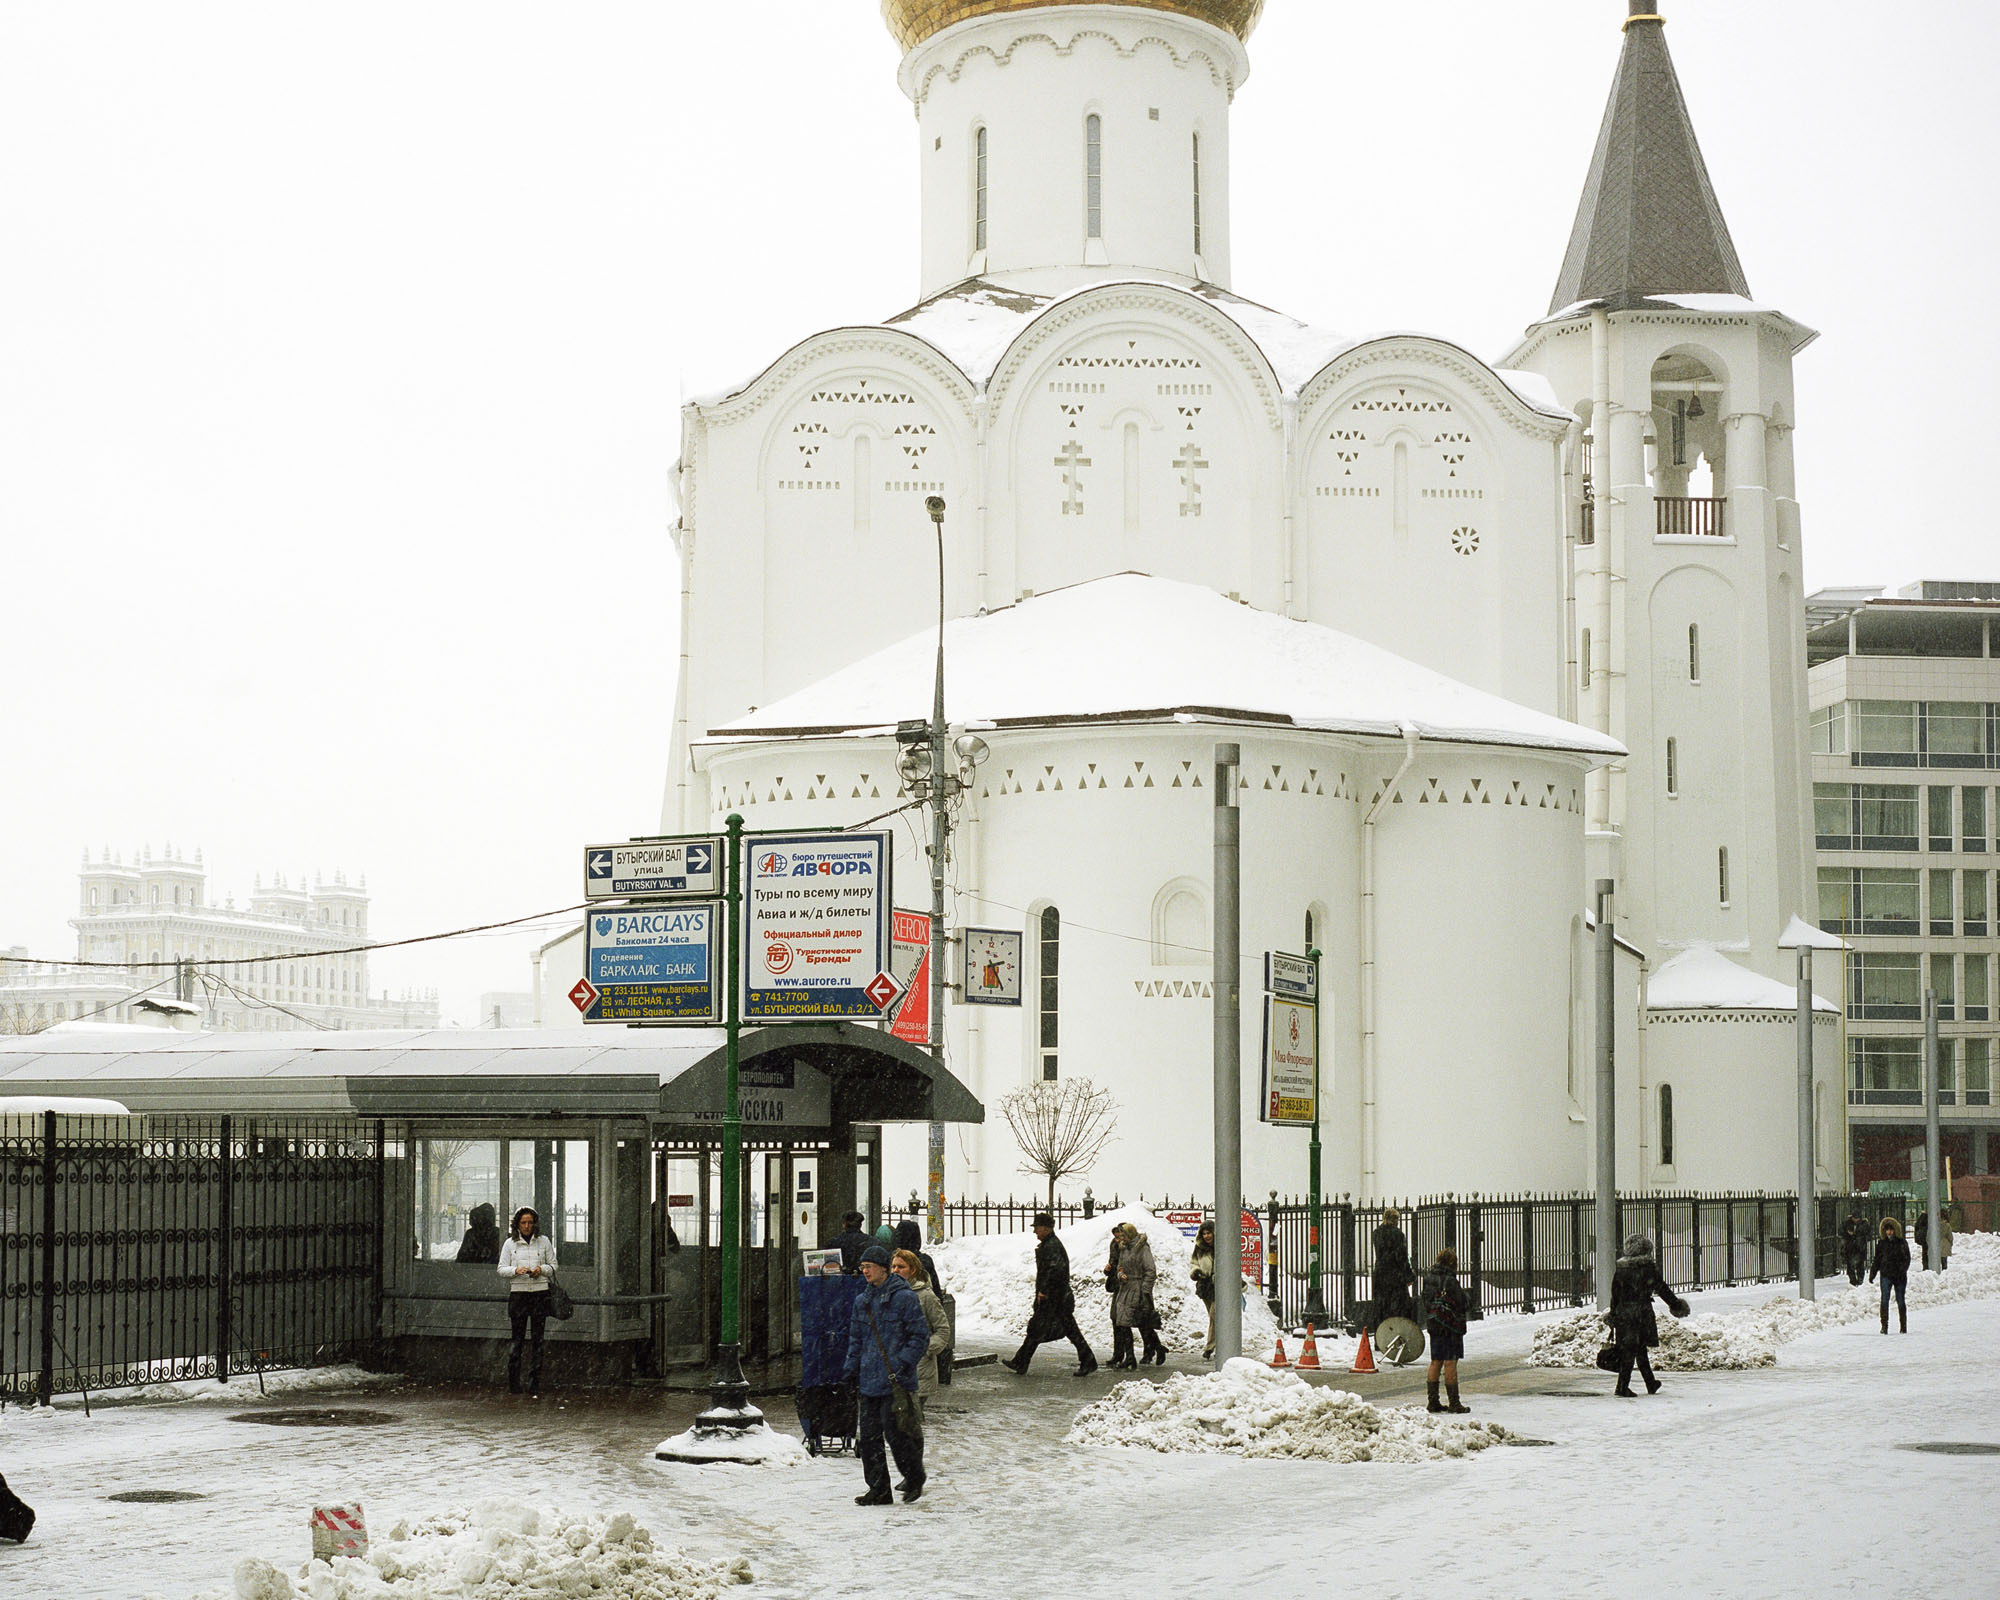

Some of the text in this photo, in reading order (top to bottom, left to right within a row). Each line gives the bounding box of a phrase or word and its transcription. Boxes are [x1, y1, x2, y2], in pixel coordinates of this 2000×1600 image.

[616, 847, 682, 865] БУТЫРСКИЙ ВАЛ
[791, 850, 873, 862] бюро путешествий
[633, 866, 664, 877] улица
[615, 879, 685, 891] BUTYRSKIY VAL st.
[754, 886, 874, 902] Туры по всему миру
[757, 906, 871, 921] Авиа и ж/д билеты
[616, 913, 705, 934] BARCLAYS
[892, 915, 928, 942] XEROX
[763, 928, 863, 941] Официальный дилер
[615, 936, 690, 946] Банкомат 24 часа
[988, 941, 995, 949] 12
[795, 947, 863, 956] Туристические
[600, 953, 644, 963] Отделение
[805, 955, 852, 965] Бренды
[971, 960, 977, 968] 9
[665, 962, 696, 975] БАНК
[774, 976, 852, 987] www.aurore.ru
[614, 985, 709, 995] 231-1111 www.barclays.ru
[614, 995, 682, 1007] ул. ЛЕСНАЯ, д. 5
[764, 992, 809, 1002] 741-7700
[904, 981, 920, 1014] ЦЕНТР
[602, 1008, 614, 1019] БЦ
[750, 1007, 762, 1015] ул.
[764, 1002, 821, 1015] БУТЫРСКИЙ
[822, 1004, 845, 1015] ВАЛ,
